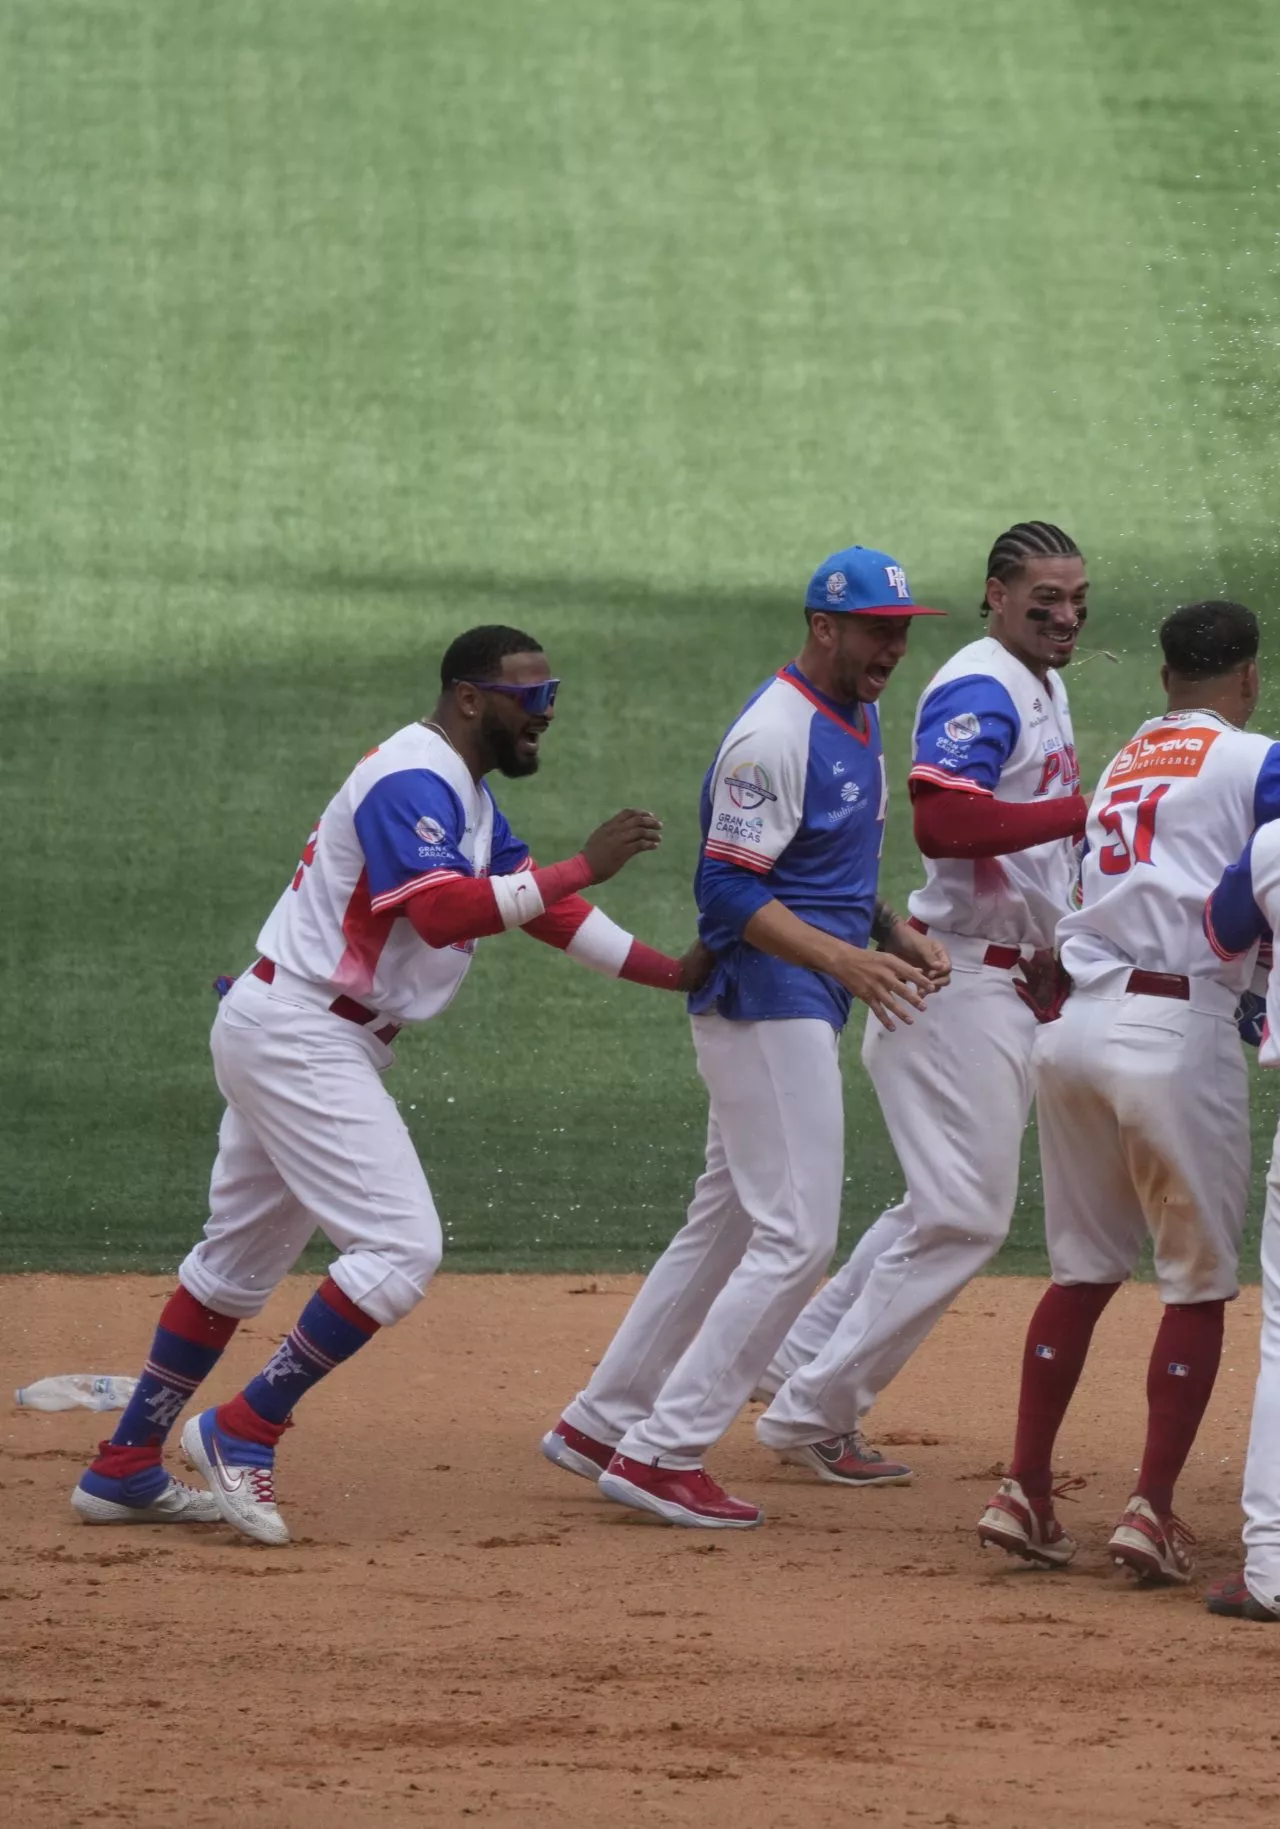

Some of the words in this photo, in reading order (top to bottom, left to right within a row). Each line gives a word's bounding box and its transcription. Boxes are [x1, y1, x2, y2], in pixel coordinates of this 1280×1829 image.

[1140, 738, 1204, 757] brava
[1133, 755, 1197, 770] lubricants
[718, 812, 743, 828] GRAN
[1098, 783, 1172, 876] 51
[715, 822, 761, 844] CARACAS
